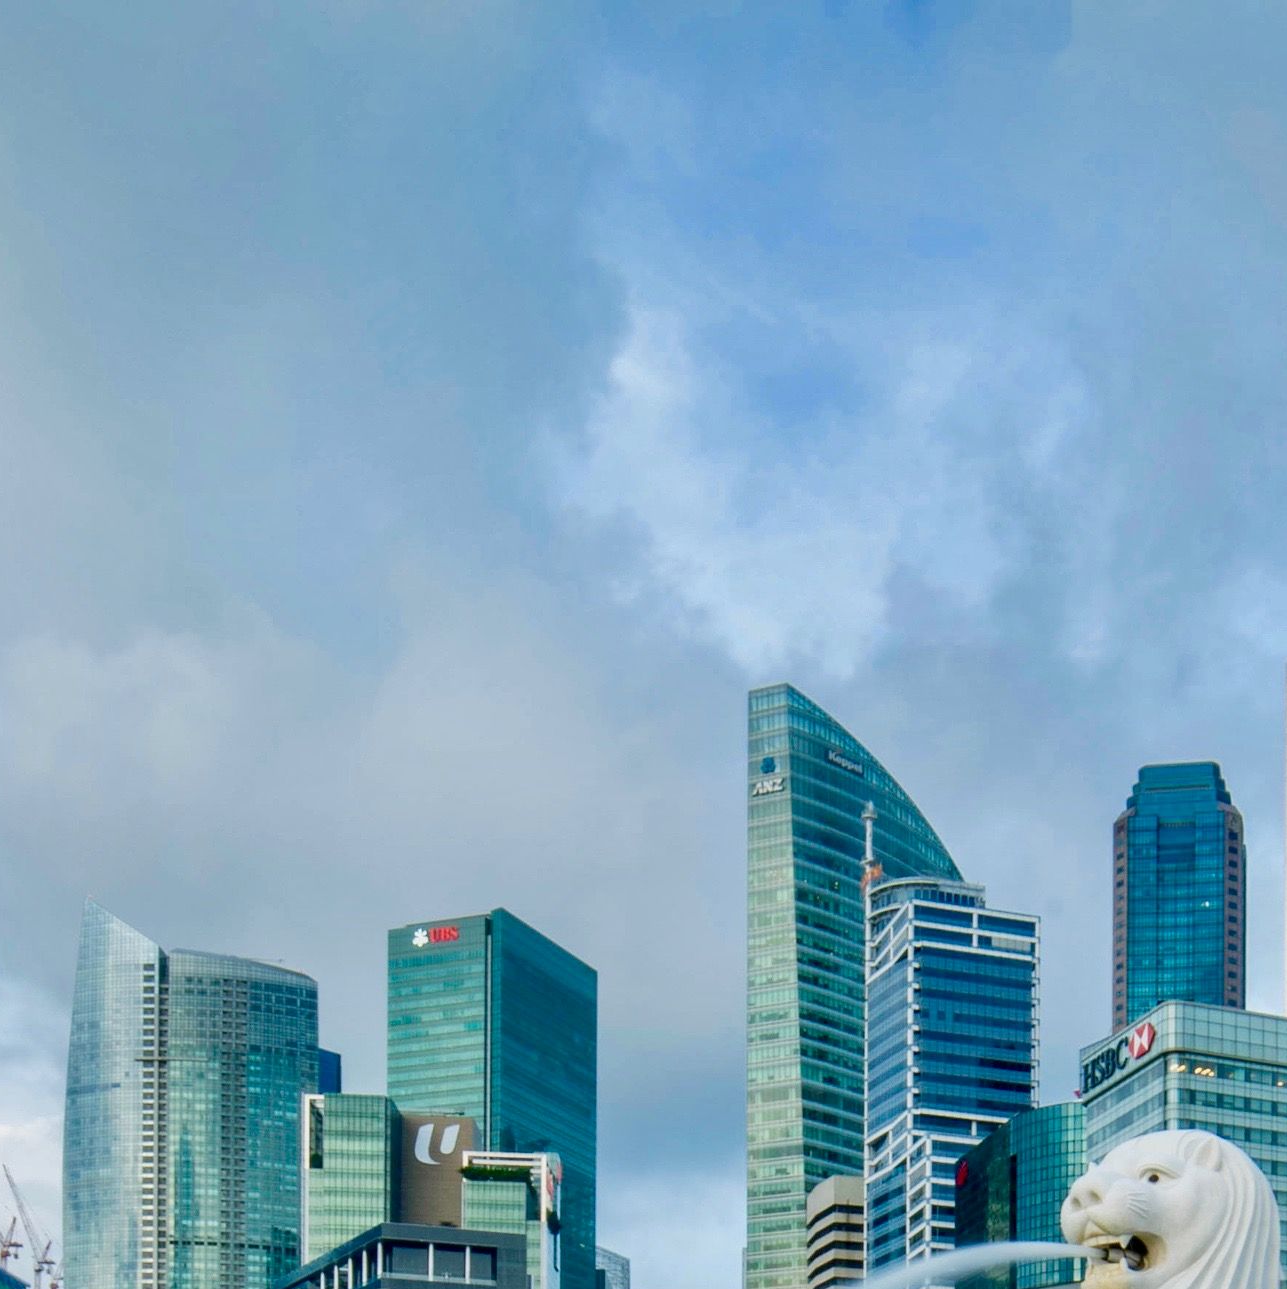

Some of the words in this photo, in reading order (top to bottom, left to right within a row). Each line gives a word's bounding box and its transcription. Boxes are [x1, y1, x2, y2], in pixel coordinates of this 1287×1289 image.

[828, 749, 864, 776] Keppel
[752, 778, 785, 797] ANZ
[428, 926, 460, 944] UBS
[1081, 1036, 1129, 1094] HSBC
